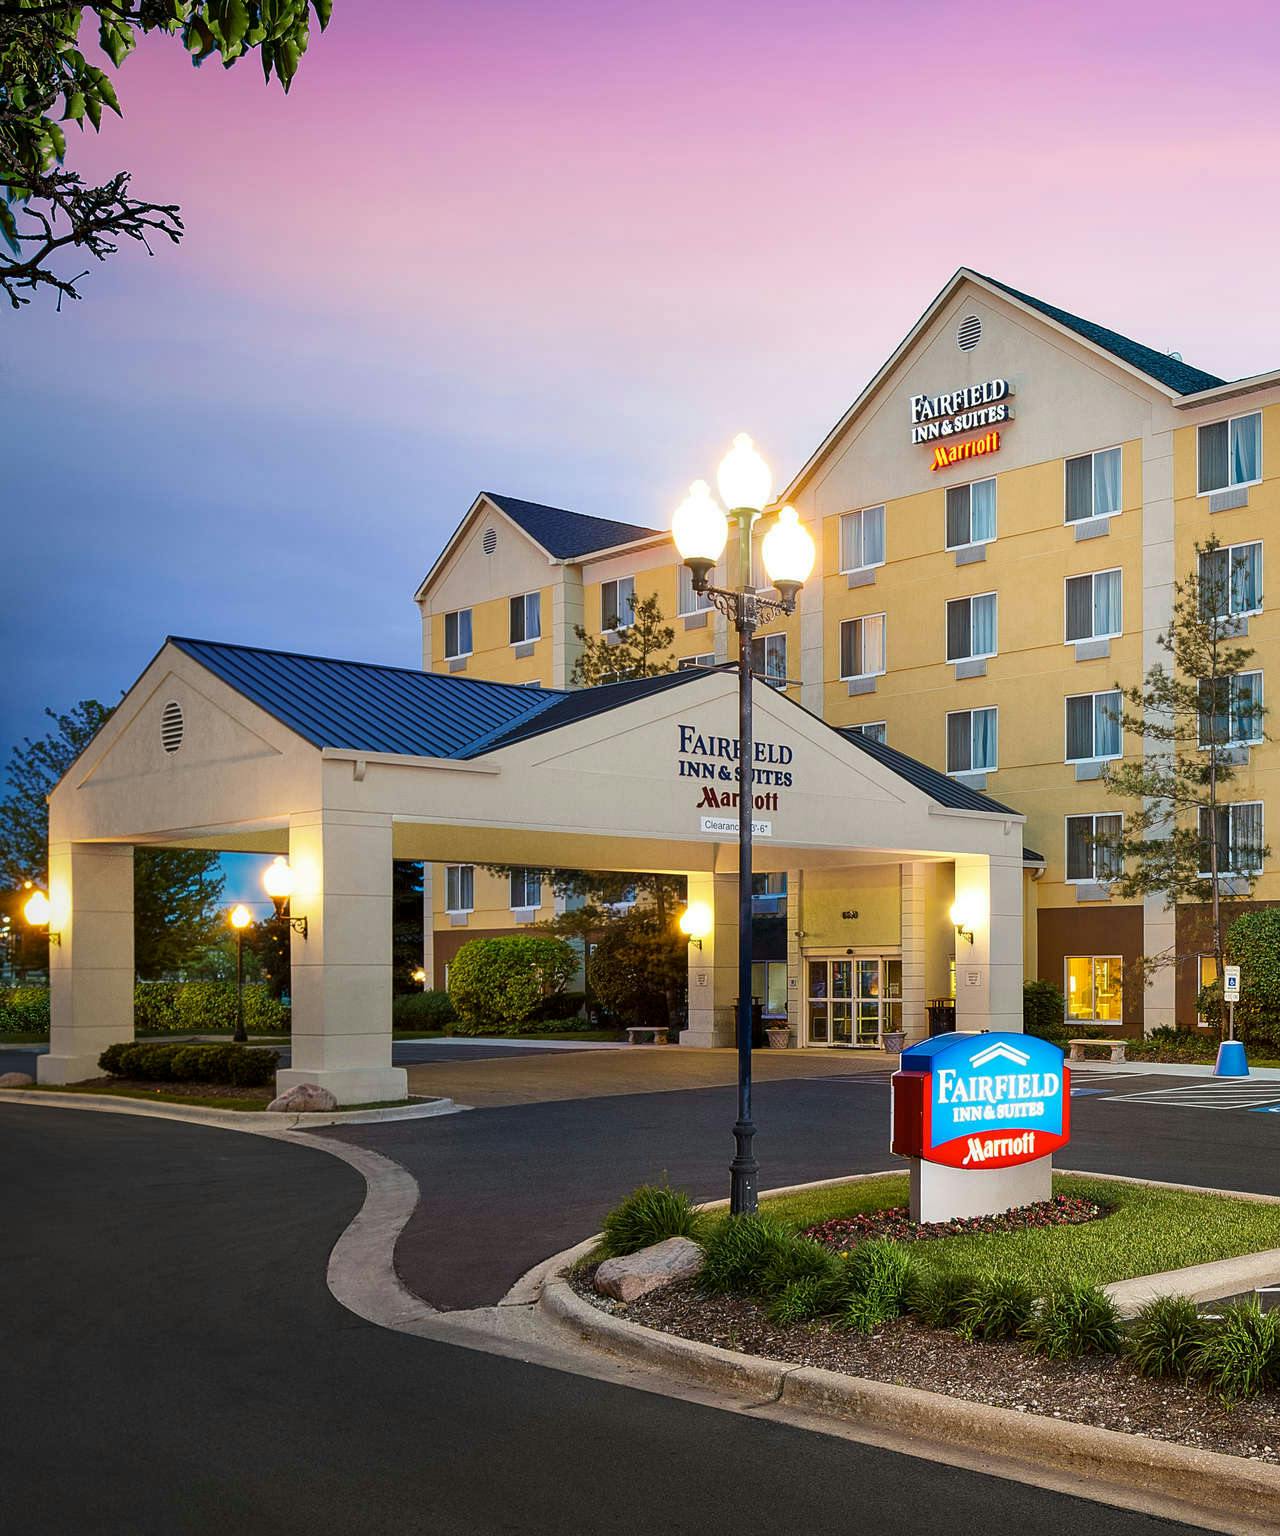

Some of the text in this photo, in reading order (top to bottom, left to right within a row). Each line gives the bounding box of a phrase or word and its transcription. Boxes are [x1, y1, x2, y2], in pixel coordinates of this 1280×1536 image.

[910, 379, 1008, 424] FAIRFIELD
[911, 404, 1008, 444] INN & SUITES
[929, 431, 1000, 471] Marriott
[678, 724, 793, 765] FAIRFELD
[678, 760, 716, 780] INN
[718, 765, 732, 781] &
[696, 785, 778, 811] Marott
[704, 820, 740, 831] Clearanc
[937, 1069, 1059, 1103] FAIRFIELD
[953, 1101, 1044, 1122] INN & SUITES
[962, 1132, 1035, 1165] Marriott
